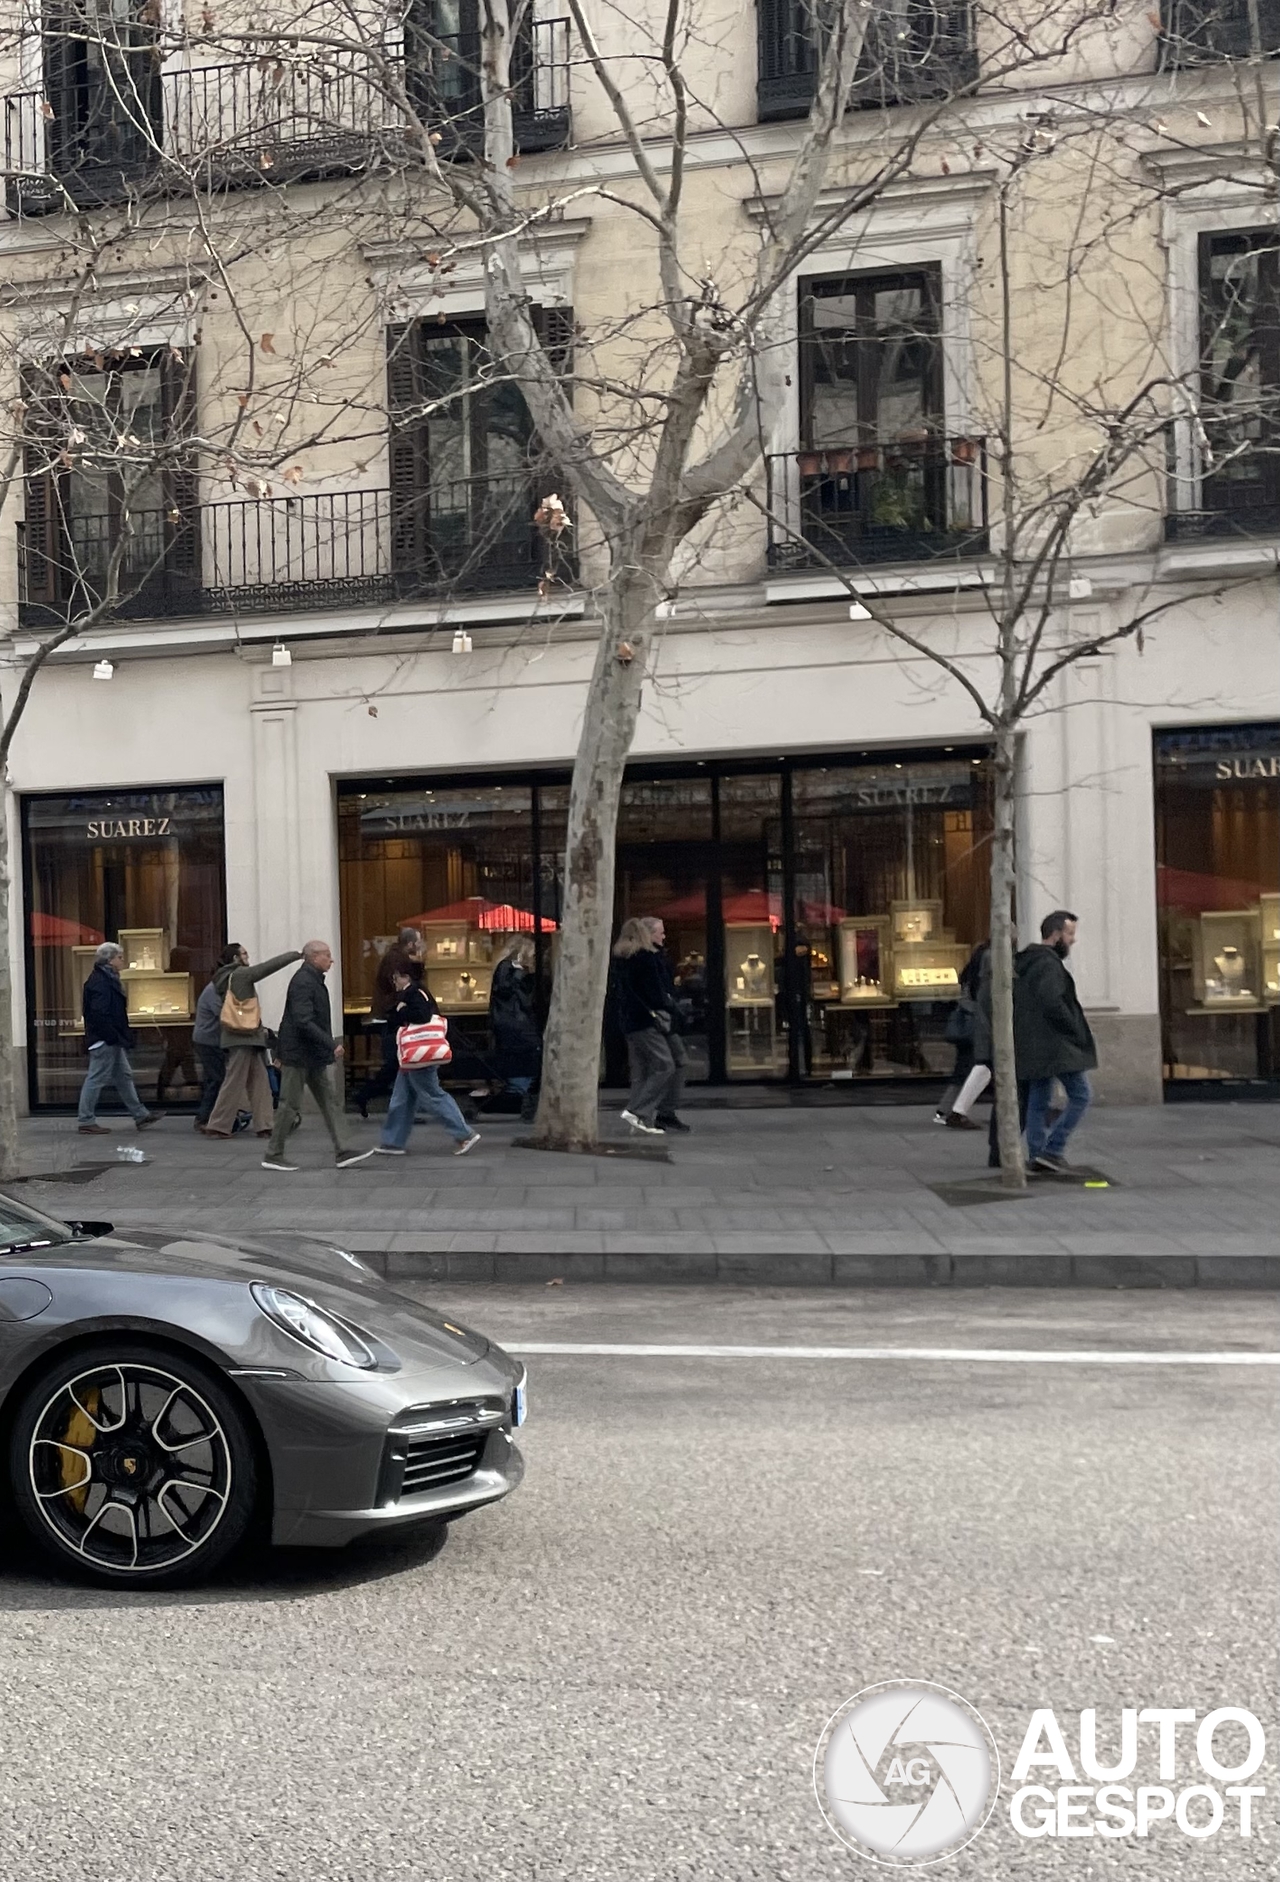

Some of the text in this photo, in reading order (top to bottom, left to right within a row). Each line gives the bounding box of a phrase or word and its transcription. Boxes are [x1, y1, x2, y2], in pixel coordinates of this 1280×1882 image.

[857, 785, 953, 807] SUAREZ
[86, 817, 171, 839] SUAREZ
[384, 812, 471, 832] SUAREZ
